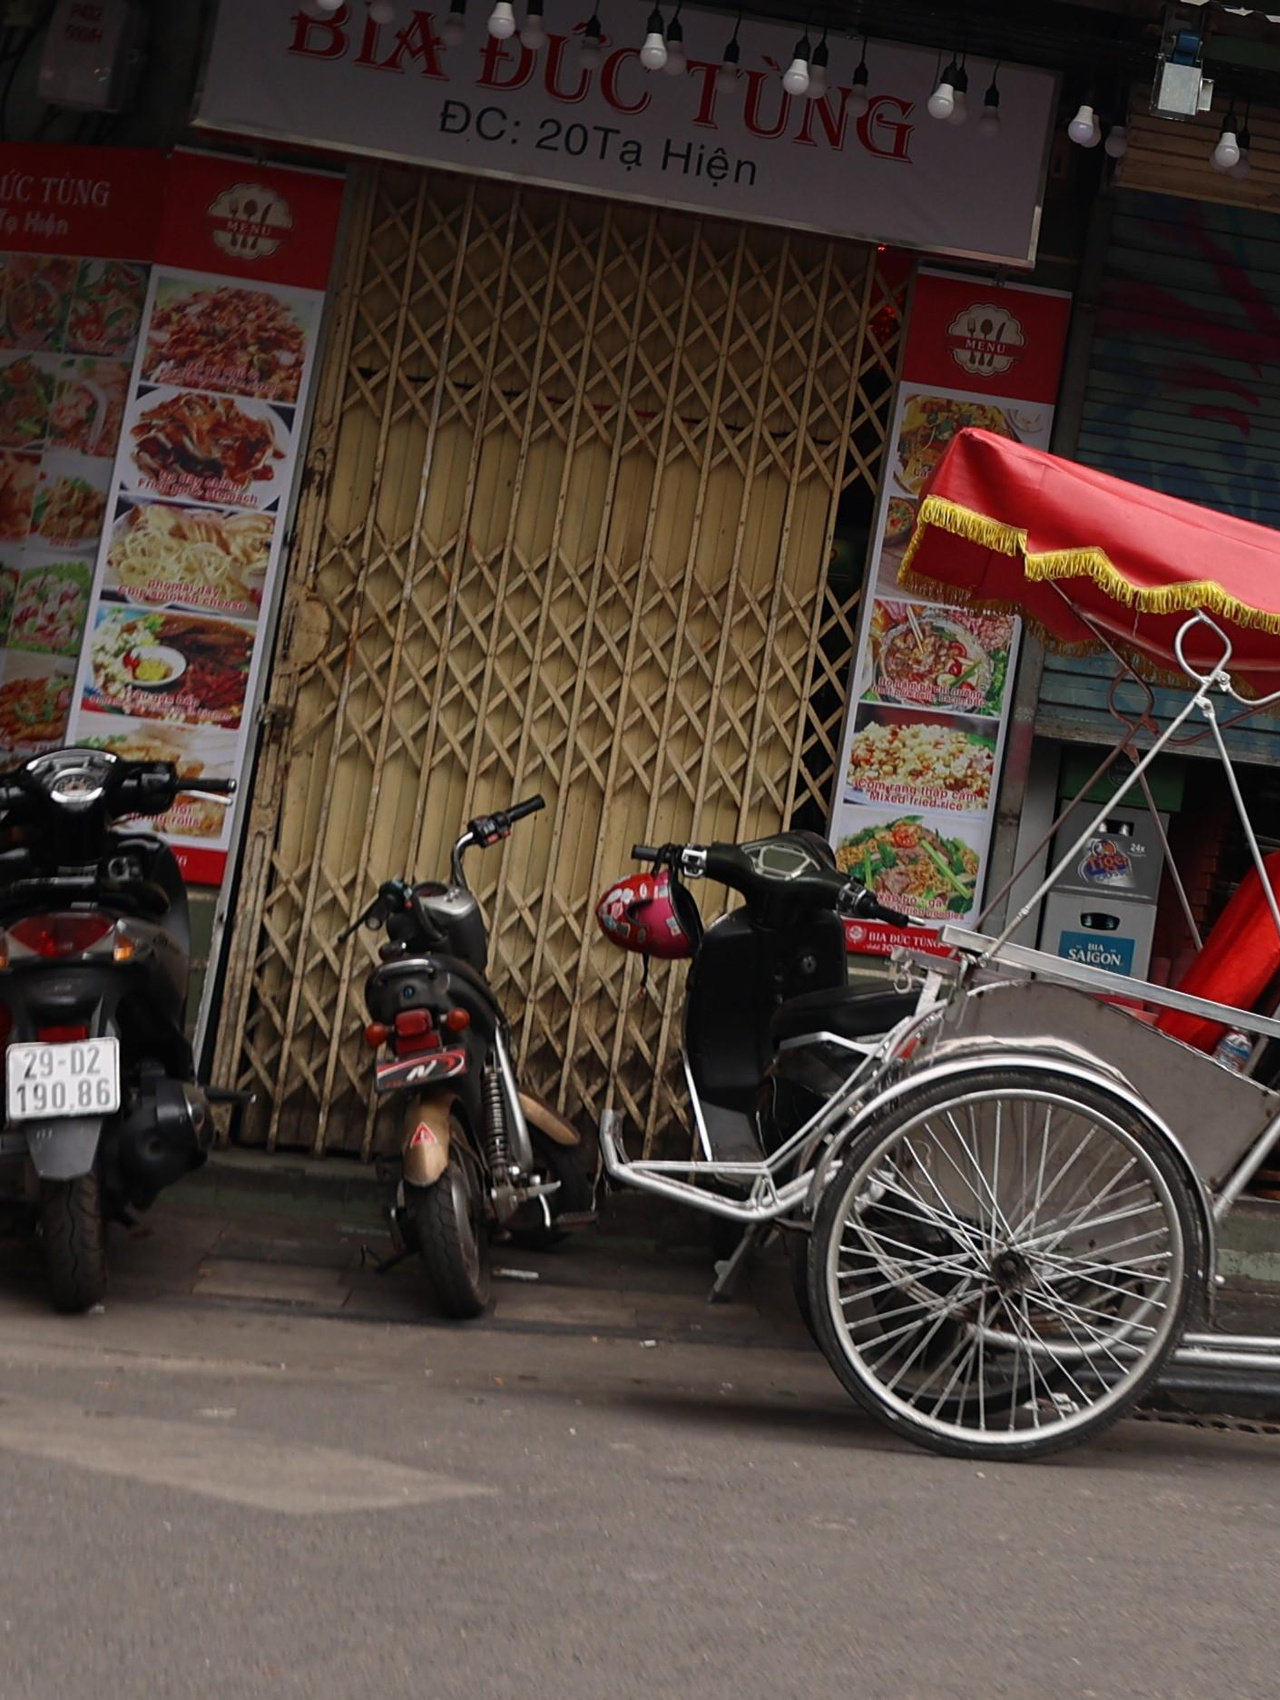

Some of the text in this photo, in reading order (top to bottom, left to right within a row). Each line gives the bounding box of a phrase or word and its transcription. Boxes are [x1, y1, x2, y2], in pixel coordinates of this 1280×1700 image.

[288, 4, 450, 82] BIA
[686, 55, 917, 164] TÙNG
[534, 118, 642, 171] 20Tạ
[661, 136, 758, 187] Hiện
[226, 219, 273, 237] MENU
[964, 337, 1007, 355] MENU
[889, 784, 917, 797] rang
[869, 791, 963, 812] Mixed fried rice
[1130, 843, 1146, 853] 24x
[1088, 855, 1129, 872] Tiger
[868, 932, 887, 944] BIA
[1087, 943, 1104, 953] BIA
[1068, 948, 1122, 967] SAIGON
[23, 1045, 102, 1080] 29-D2
[16, 1078, 110, 1114] 190.86
